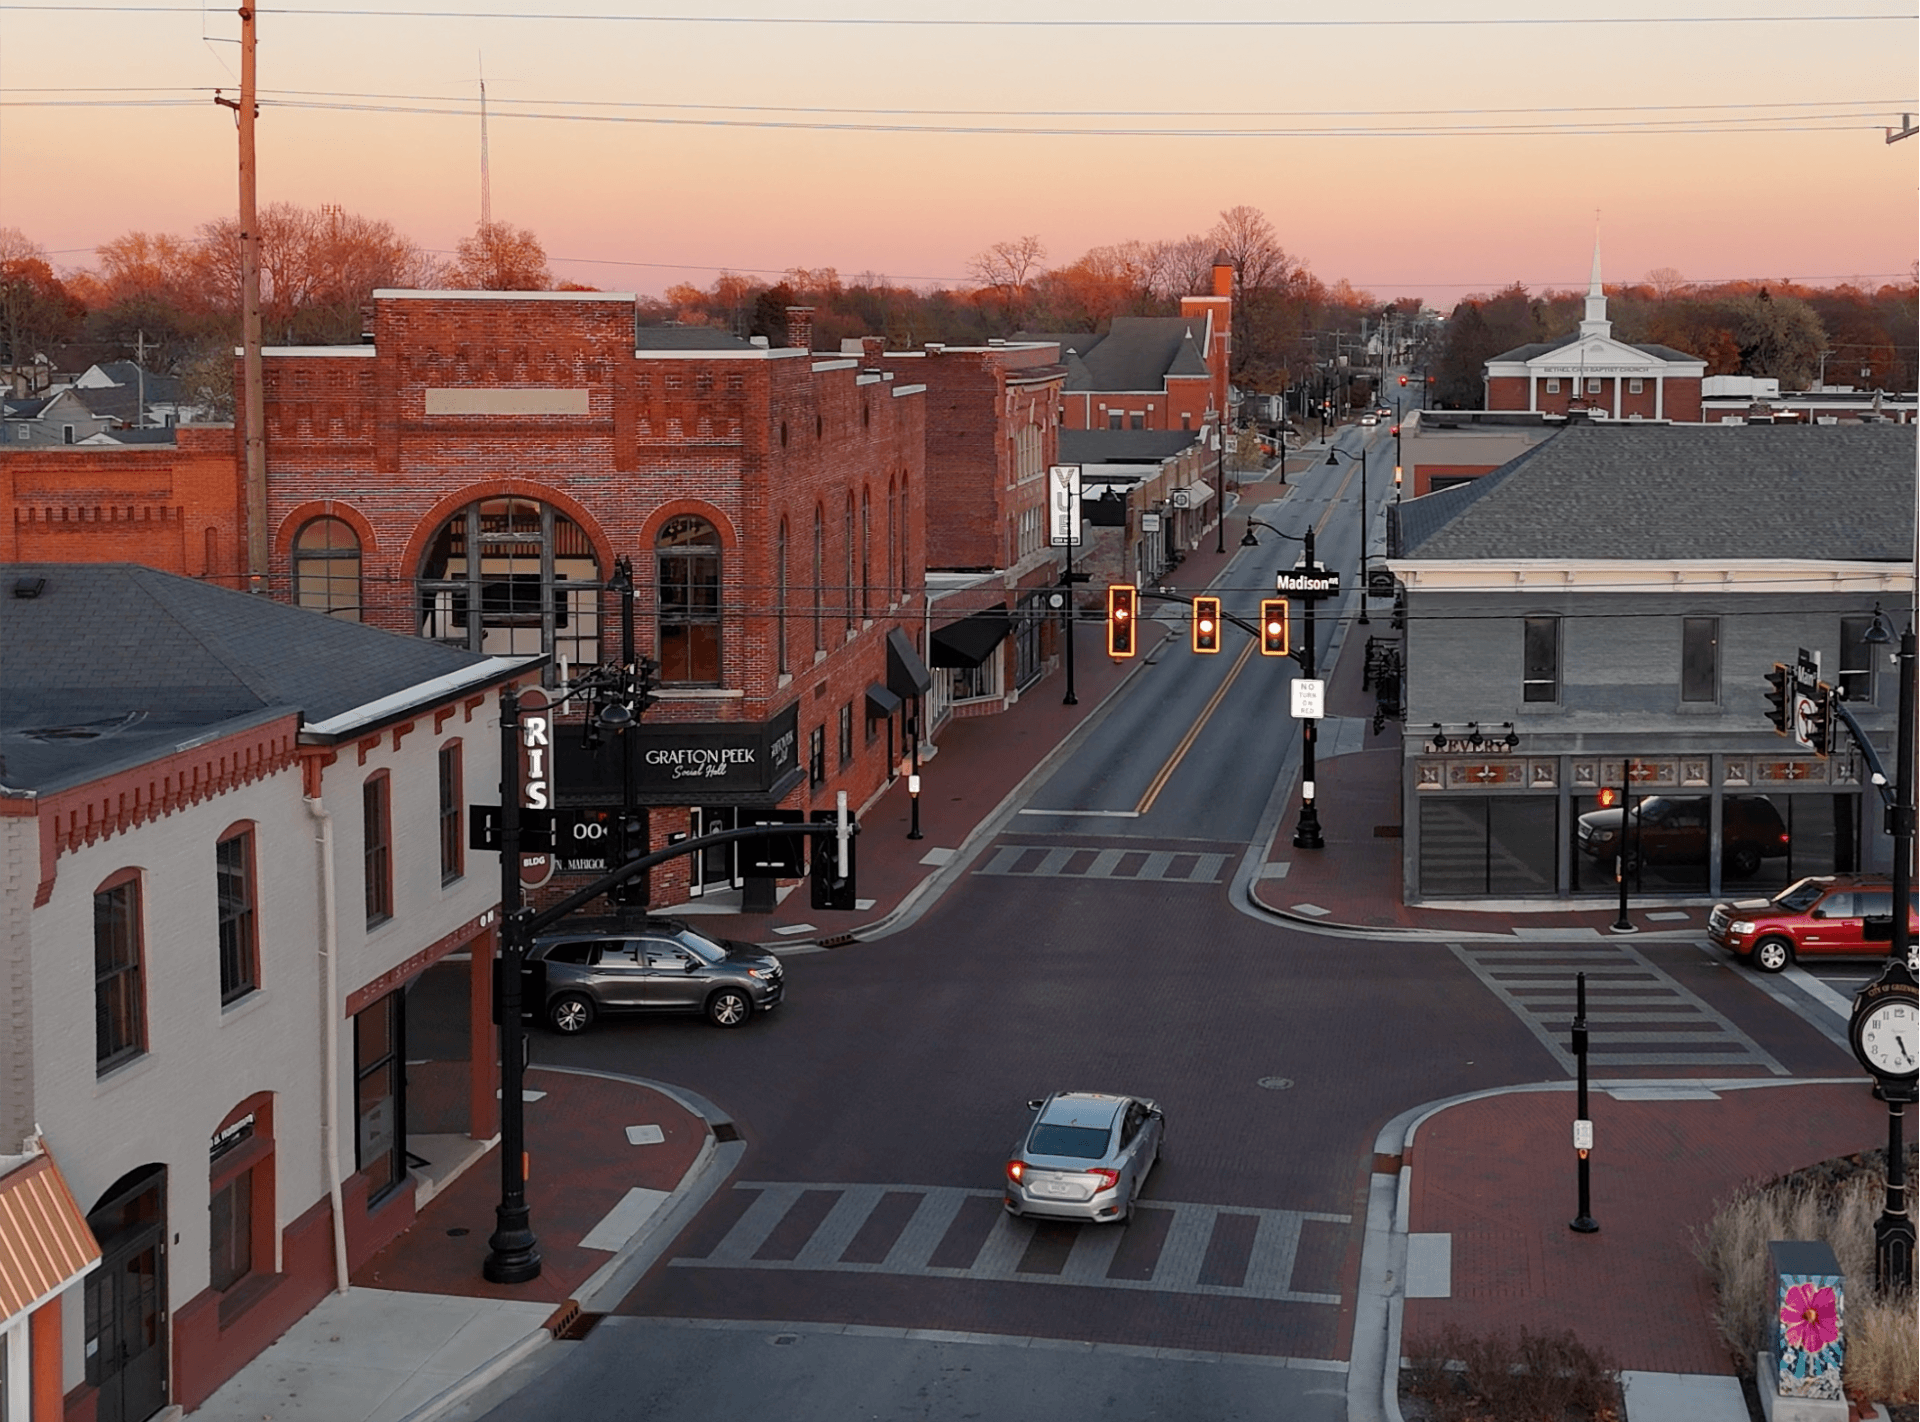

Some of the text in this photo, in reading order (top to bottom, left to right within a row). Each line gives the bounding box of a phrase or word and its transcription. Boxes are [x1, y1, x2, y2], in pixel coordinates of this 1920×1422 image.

[1277, 574, 1329, 590] Madison
[1798, 665, 1814, 687] Main
[1300, 683, 1315, 691] NO
[645, 748, 755, 764] GRAFTON PEEK
[671, 762, 728, 779] Social Hall
[523, 856, 546, 867] BLDG
[1868, 986, 1882, 997] CITY
[1882, 984, 1890, 992] OF
